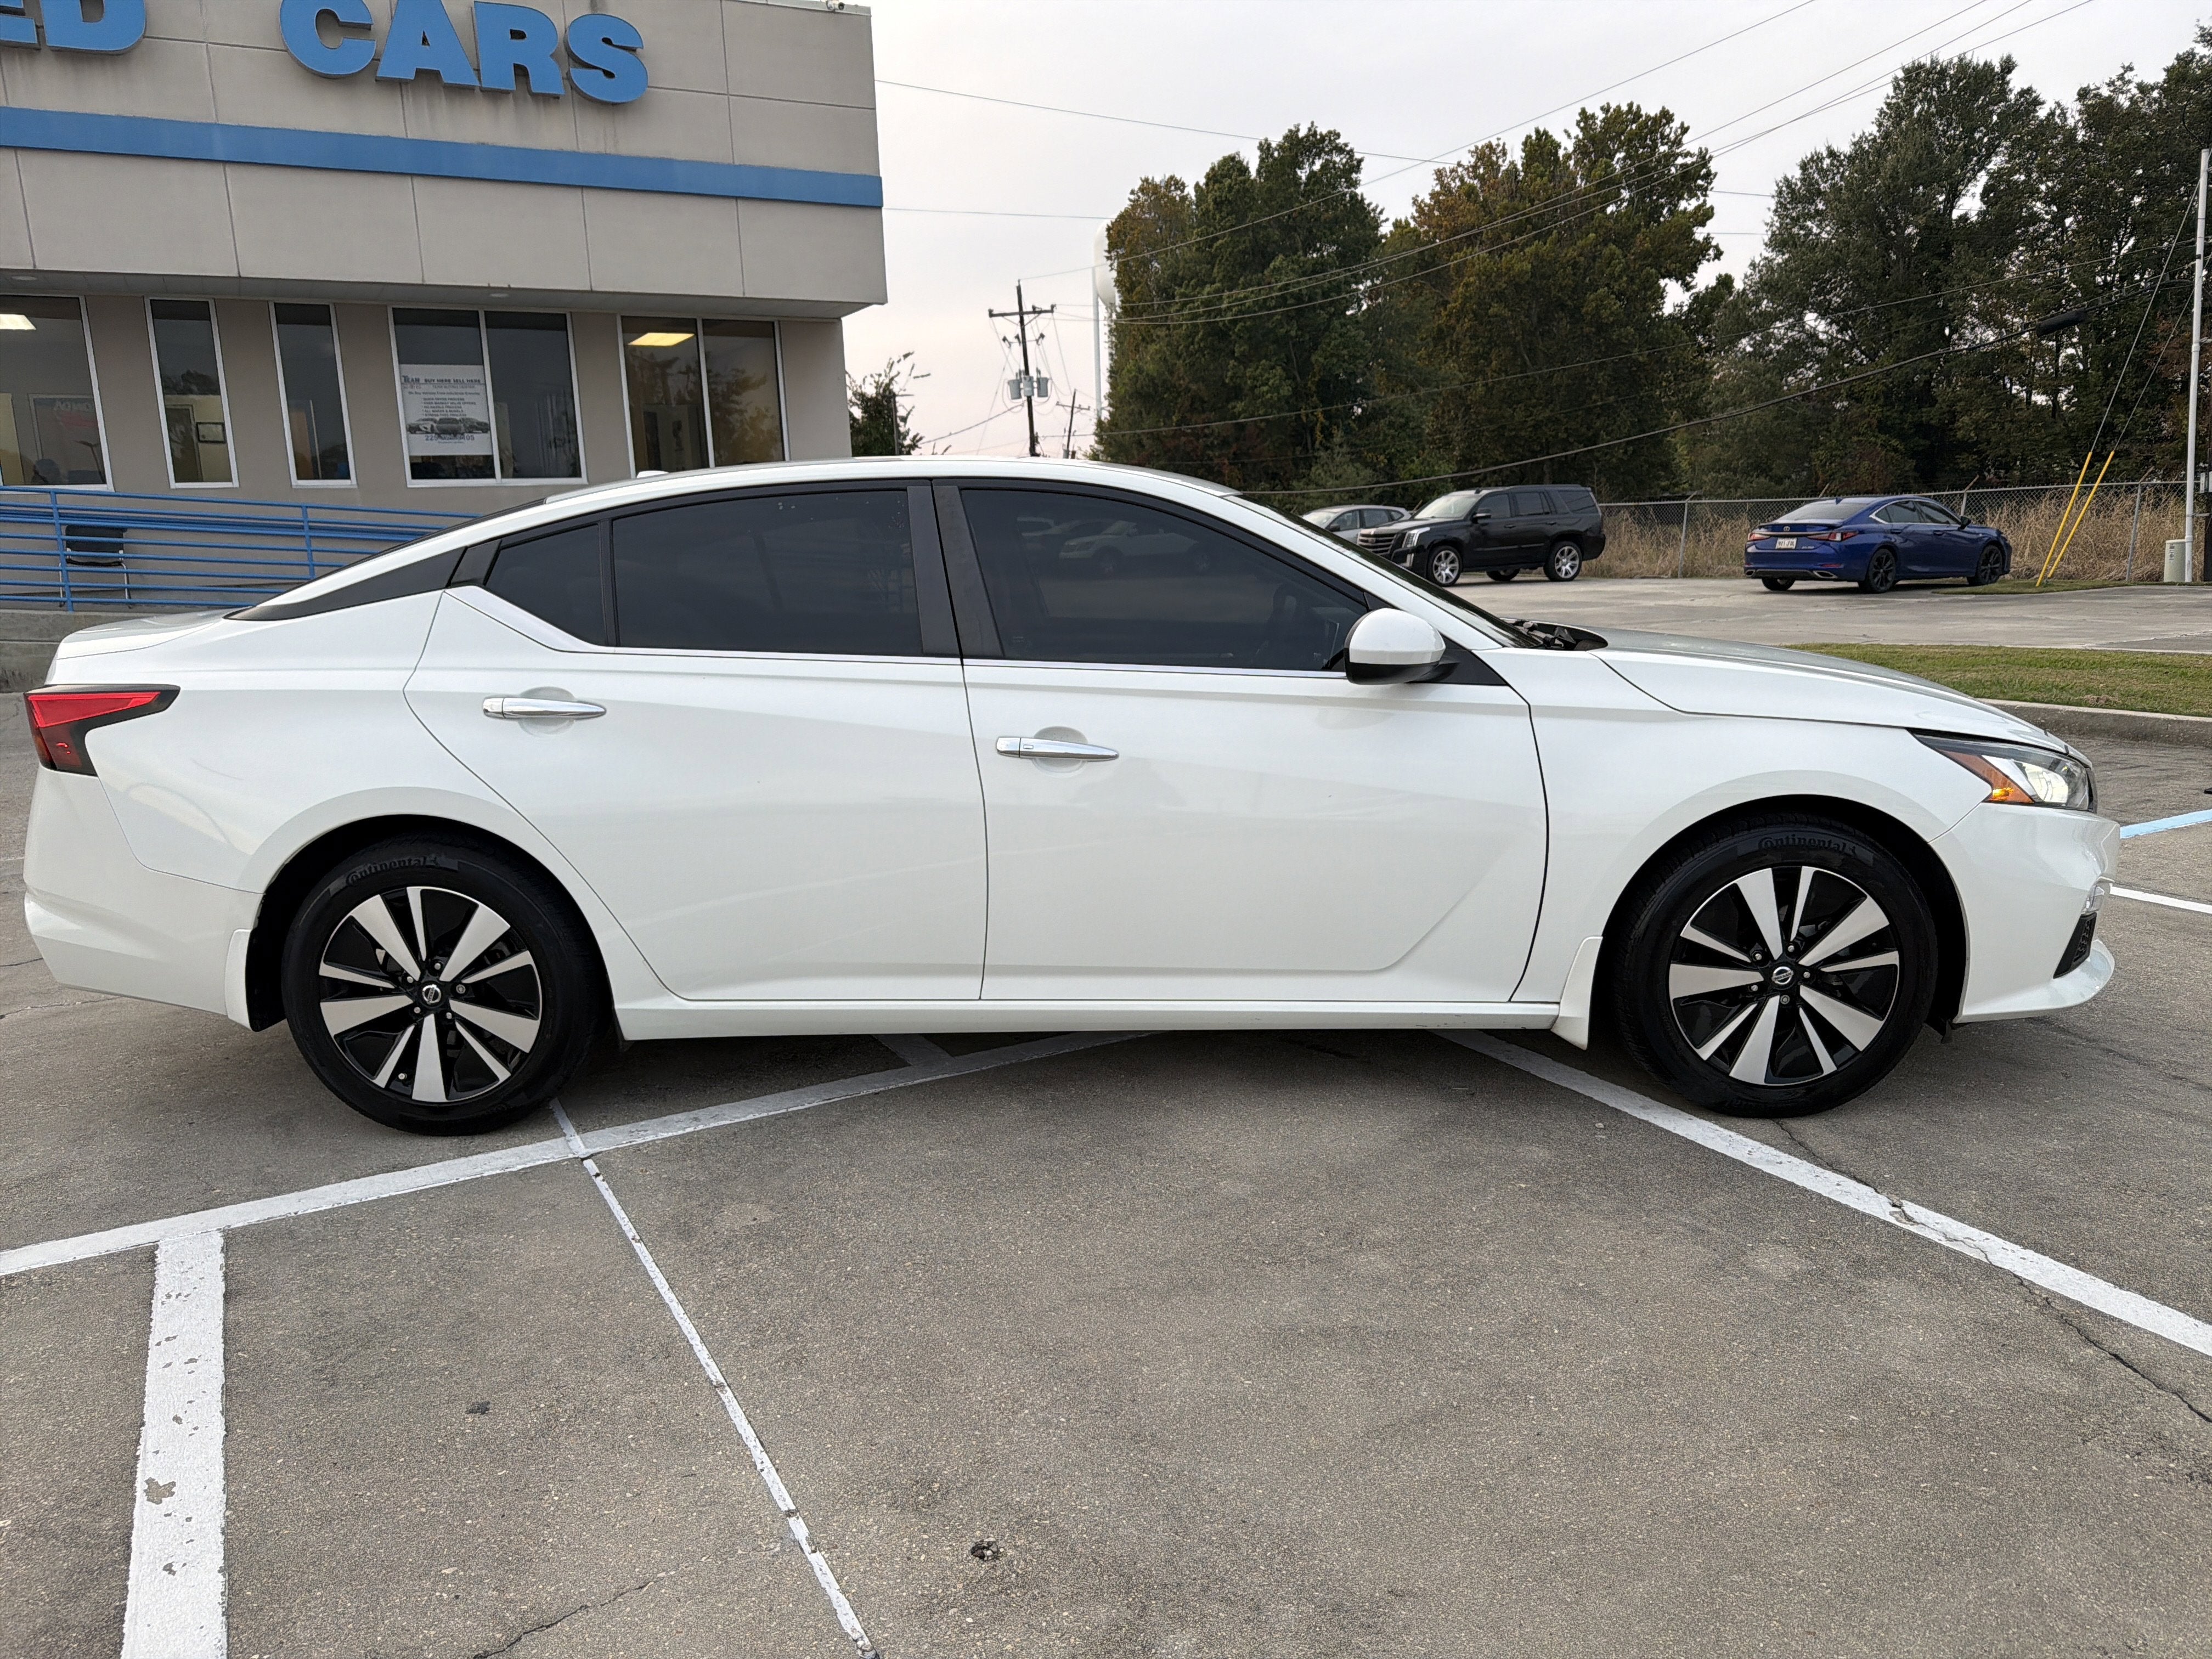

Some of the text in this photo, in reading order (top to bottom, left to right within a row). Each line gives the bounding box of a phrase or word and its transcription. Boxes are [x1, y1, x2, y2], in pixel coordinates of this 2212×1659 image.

[0, 0, 648, 104] D CARS
[1758, 834, 1847, 853] Continental
[346, 855, 426, 887] Continental
